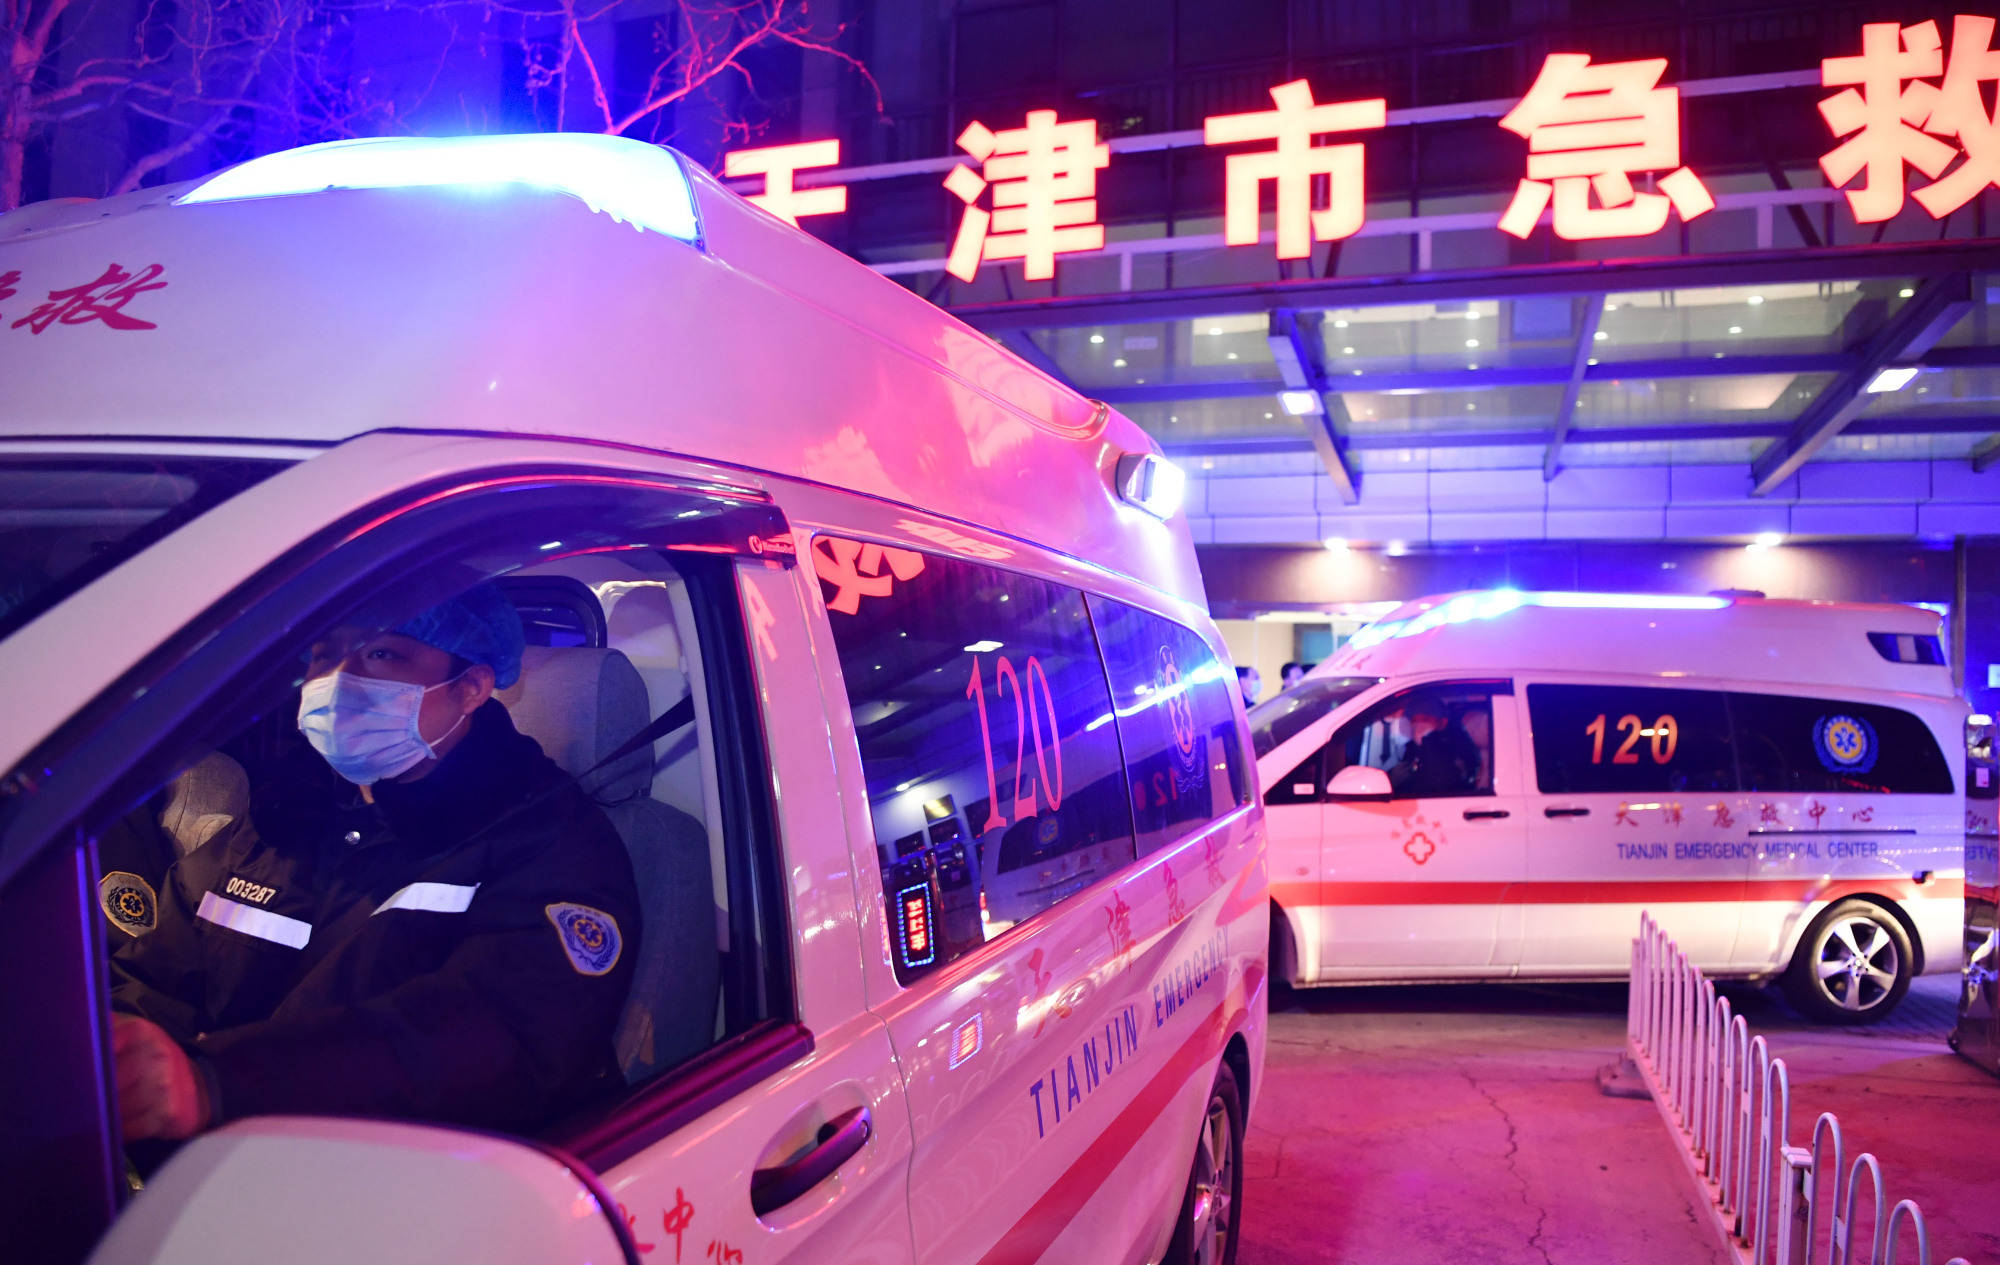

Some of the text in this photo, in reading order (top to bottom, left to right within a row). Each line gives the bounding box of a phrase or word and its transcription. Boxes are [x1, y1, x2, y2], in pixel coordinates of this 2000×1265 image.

[966, 655, 1063, 833] 120
[1586, 714, 1678, 764] 120
[1617, 841, 1878, 860] TIANJIN EMERGENCY MEDICAL CENTER
[226, 877, 277, 905] 003287
[1030, 925, 1229, 1139] TIANJIN EMERGENCY
